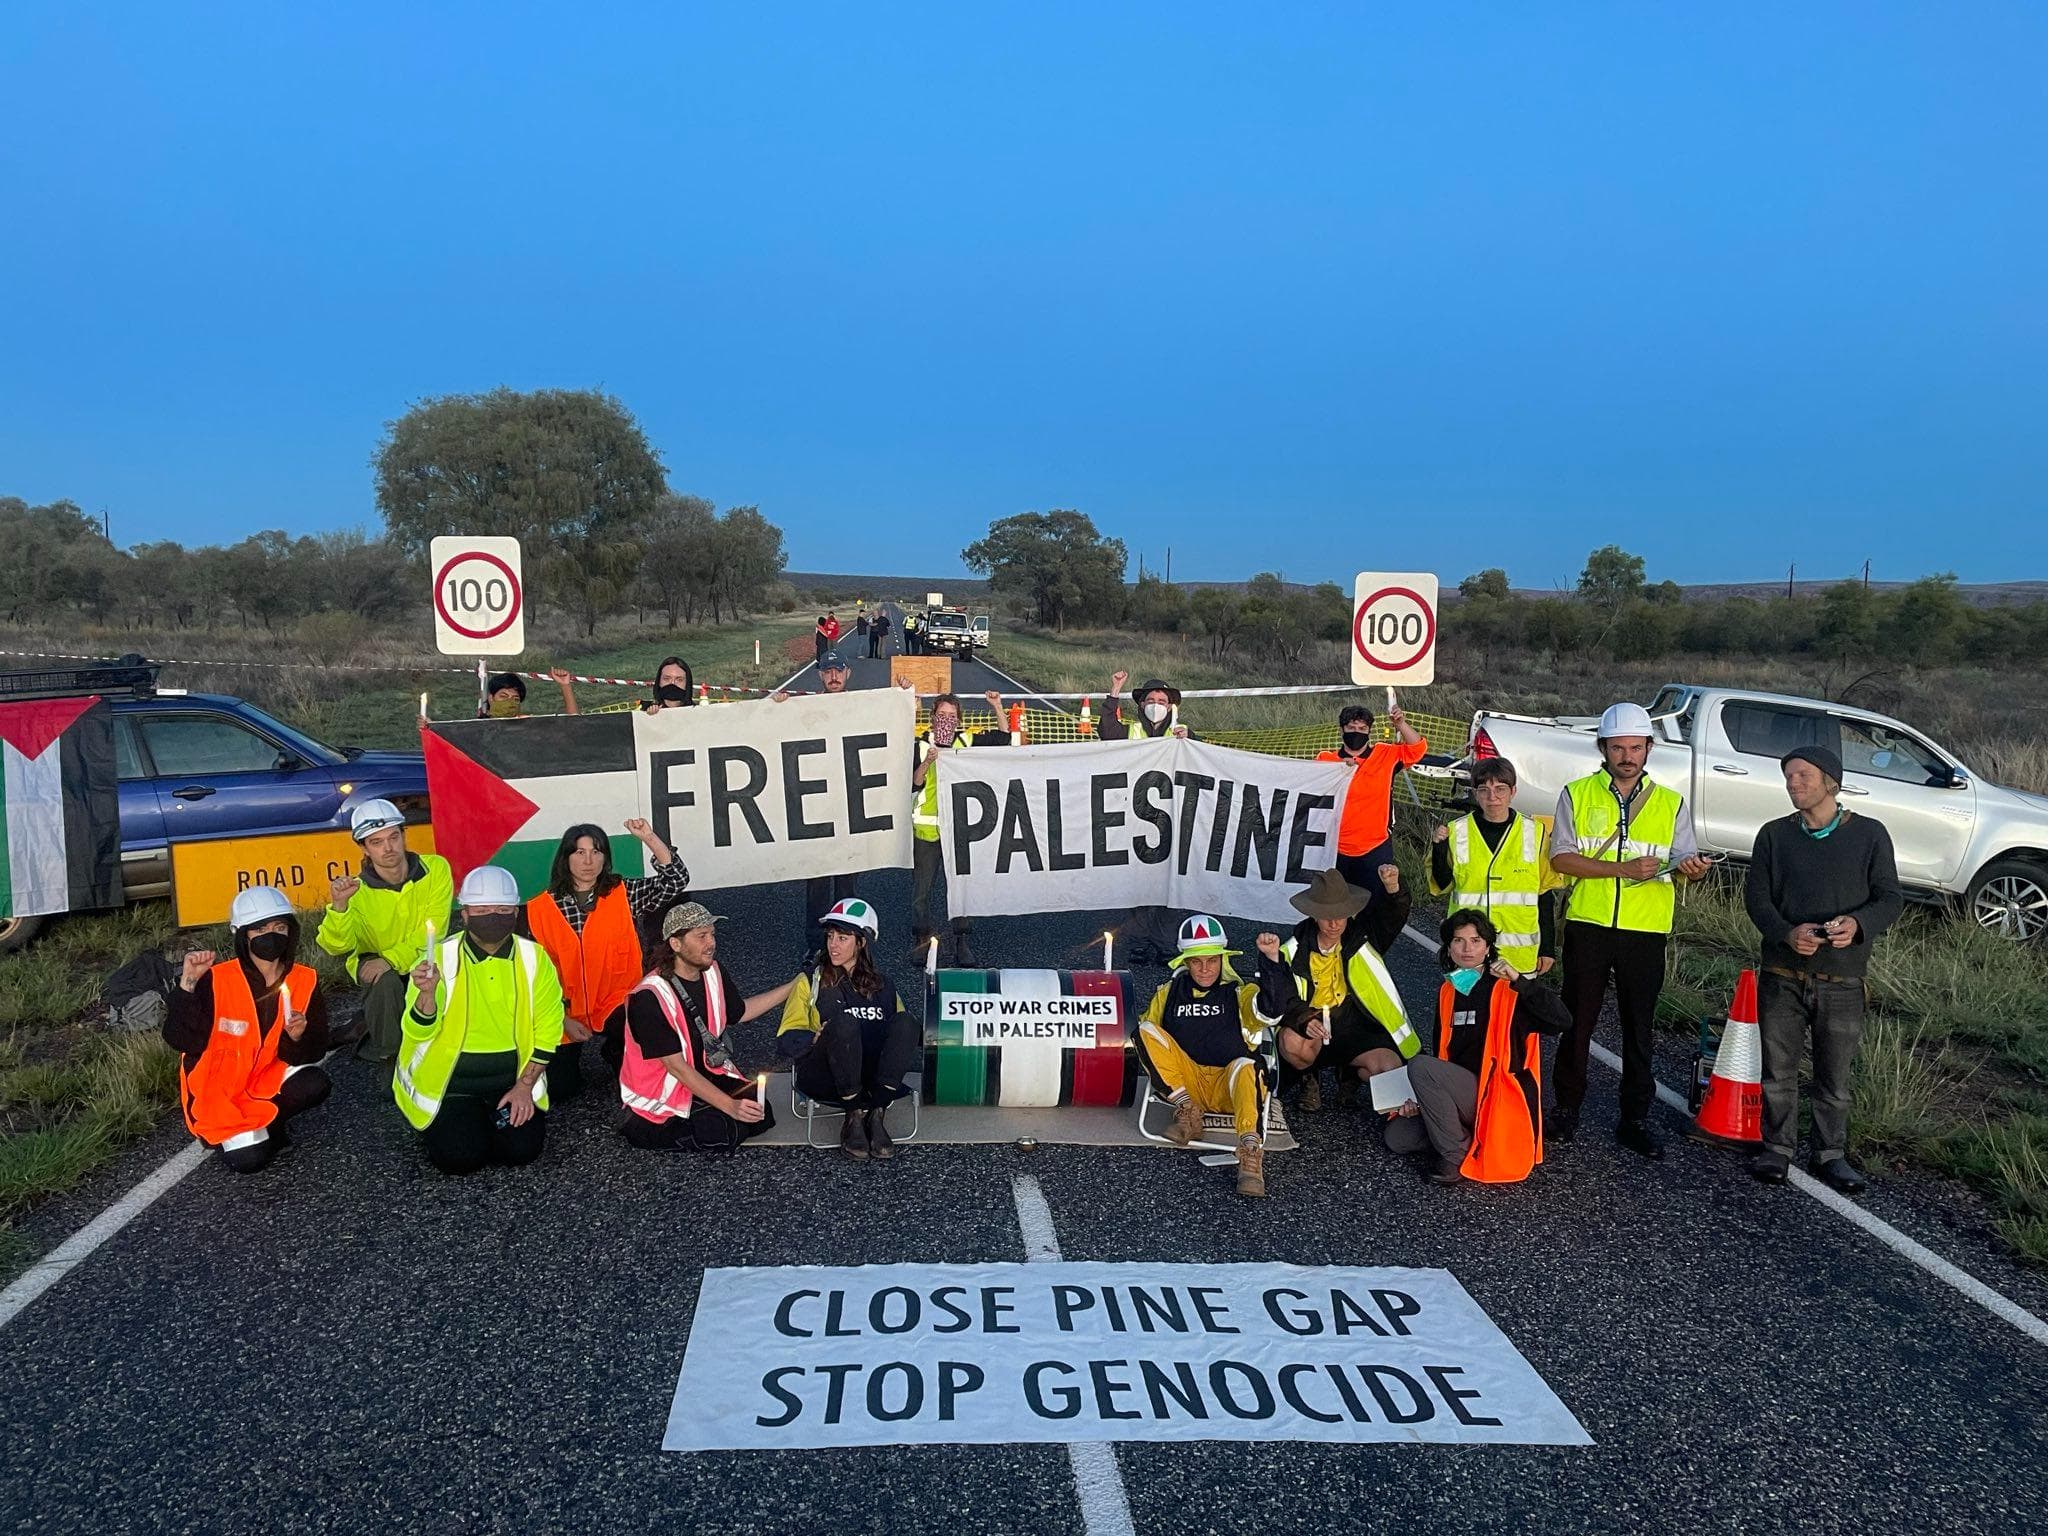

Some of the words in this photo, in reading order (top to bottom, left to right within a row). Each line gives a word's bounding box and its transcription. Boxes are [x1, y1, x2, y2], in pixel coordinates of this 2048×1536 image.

[448, 579, 508, 612] 100
[1368, 613, 1422, 645] 100
[650, 733, 893, 850] FREE
[951, 770, 1335, 884] PALESTINE
[237, 865, 305, 892] ROAD
[948, 1001, 993, 1015] STOP
[999, 1001, 1042, 1015] WAR
[1047, 1001, 1112, 1016] CRIMES
[1177, 1004, 1220, 1017] PRESS
[976, 1022, 994, 1038] IN
[999, 1022, 1095, 1038] PALESTINE
[773, 1286, 1020, 1337] CLOSE
[1051, 1285, 1241, 1335] PINE
[1262, 1288, 1421, 1337] GAP
[755, 1360, 985, 1427] STOP
[1022, 1359, 1504, 1428] GENOCIDE
